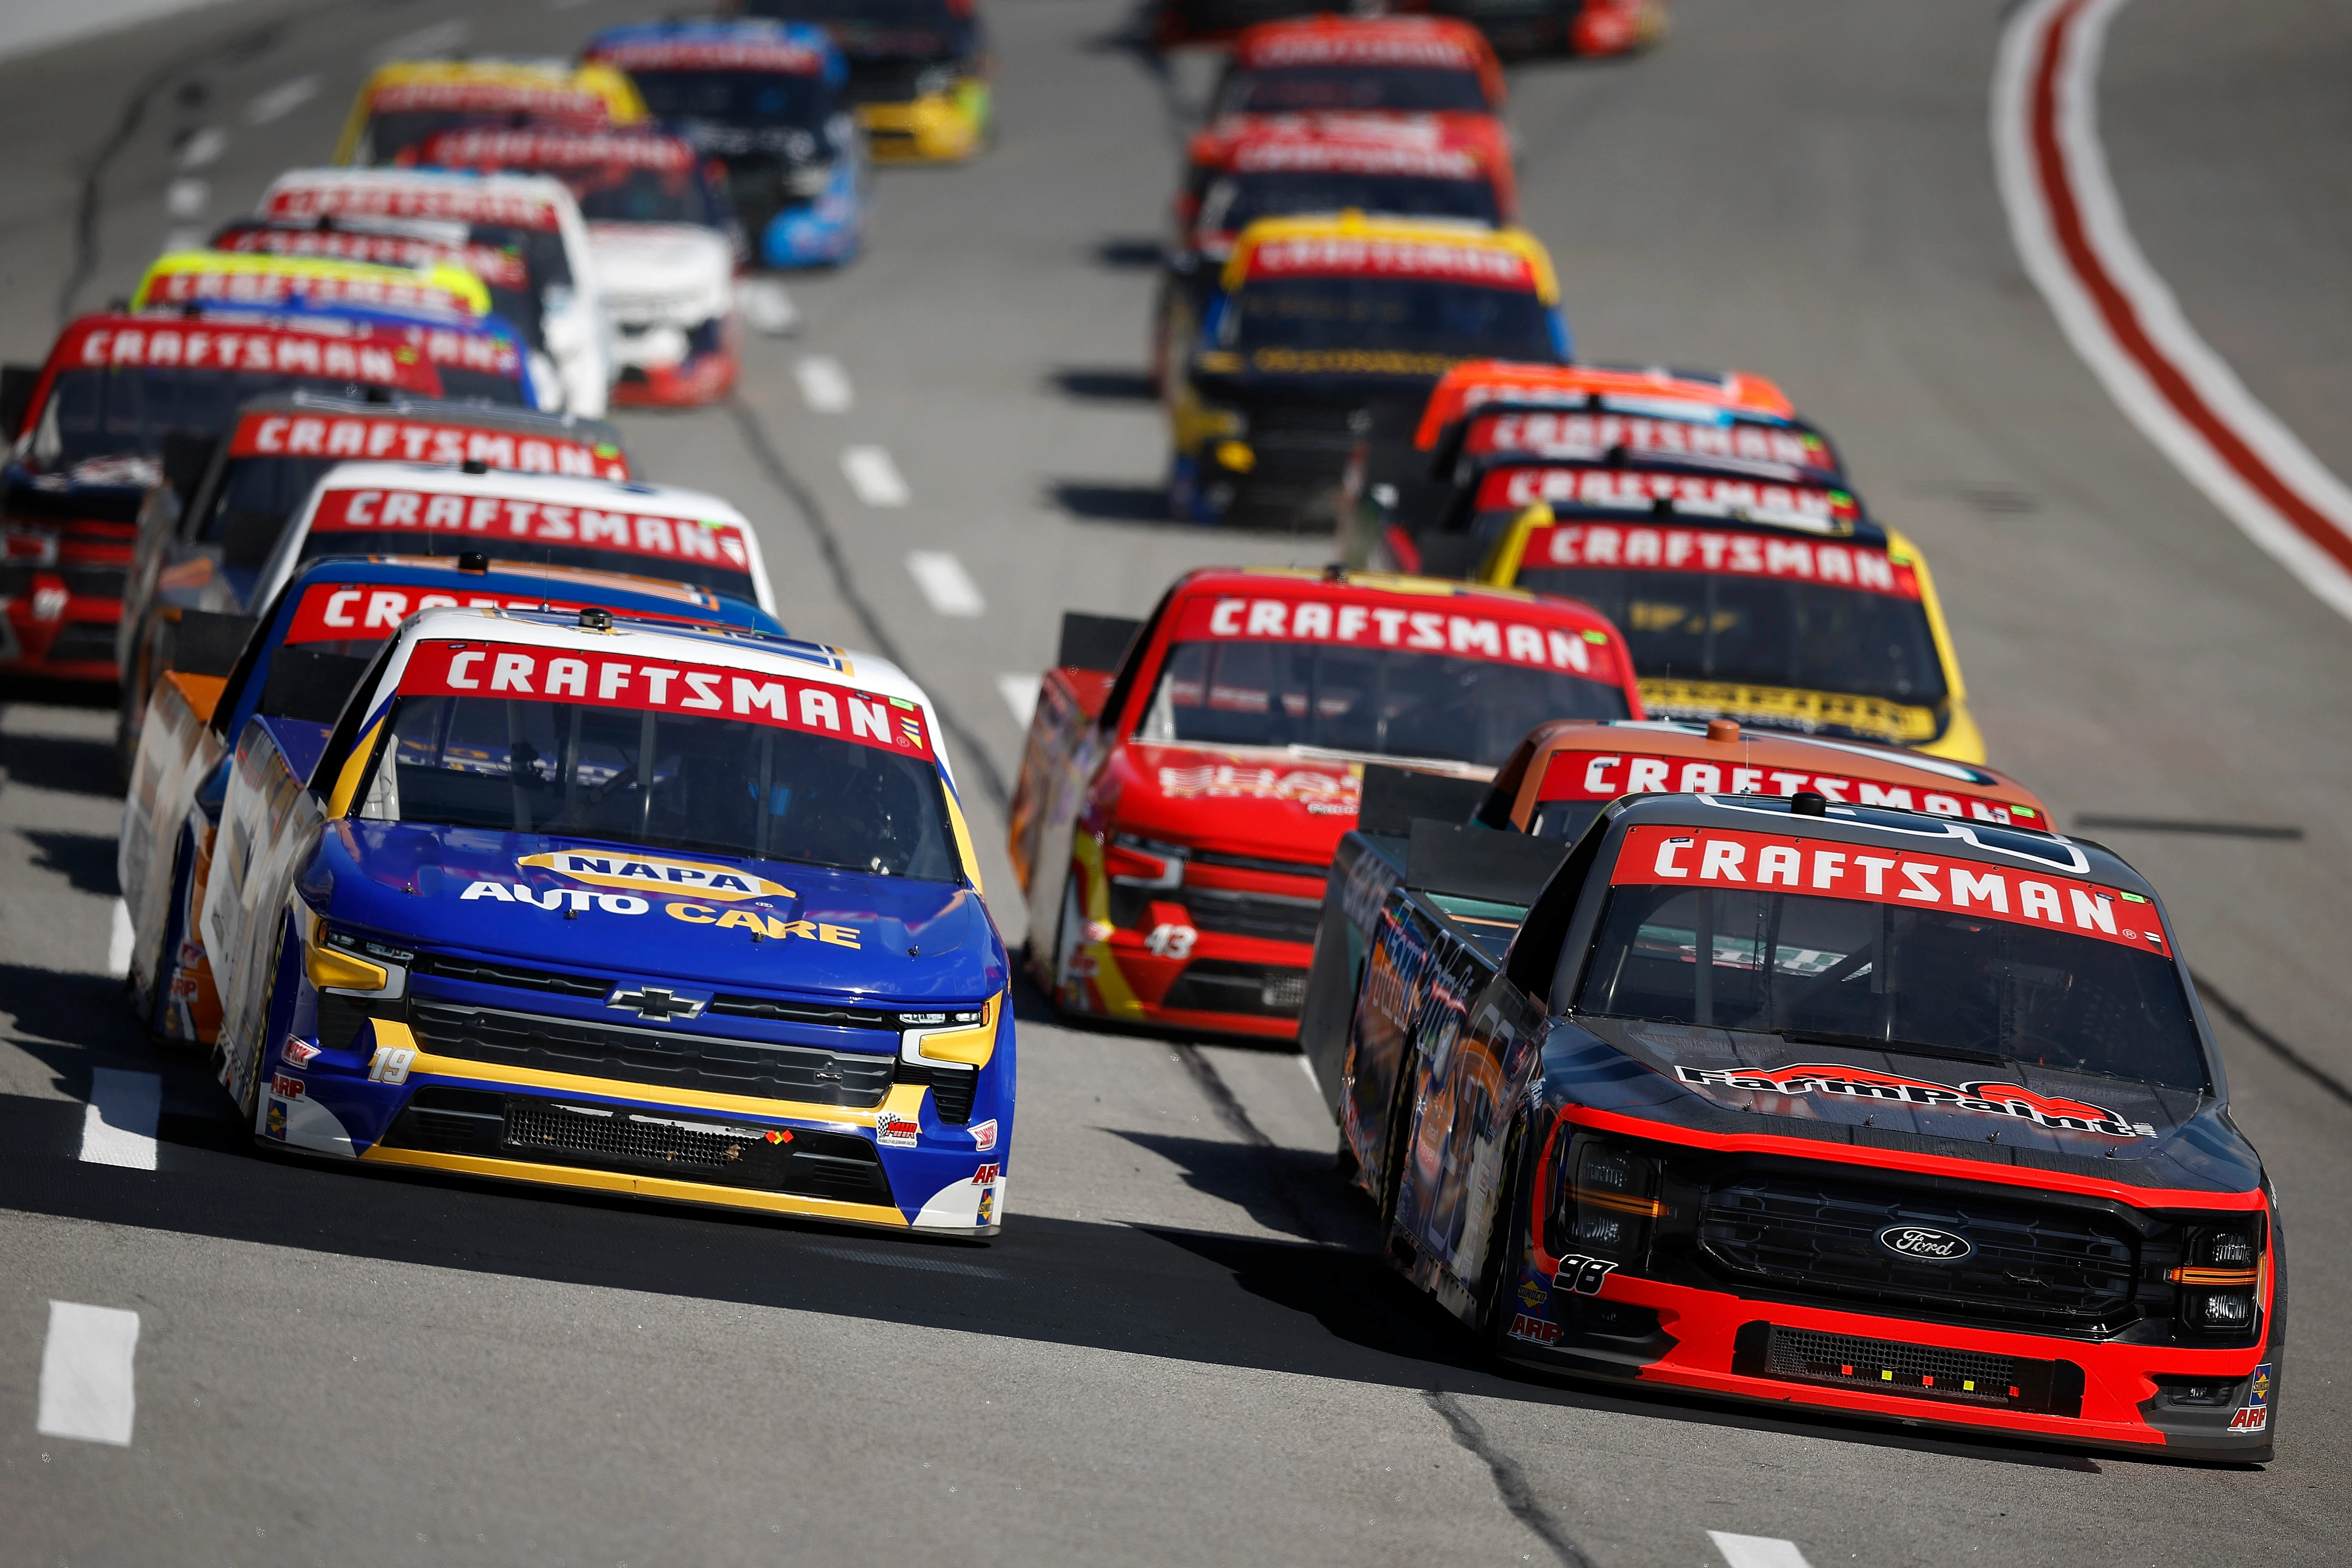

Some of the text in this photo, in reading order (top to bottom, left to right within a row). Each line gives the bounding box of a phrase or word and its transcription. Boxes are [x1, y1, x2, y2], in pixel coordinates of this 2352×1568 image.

[83, 329, 397, 382] CRAFTSMAN
[256, 418, 595, 478] CRAFTSMAN
[345, 490, 720, 559] CRAFTSMAN
[1549, 526, 1894, 589] CRAFTSMAN
[1210, 600, 1589, 673] CRAFTSMAN
[447, 652, 892, 744] CRAFTSMAN
[1583, 757, 2012, 824] CRAFTSMAN
[569, 856, 753, 892] NAPA
[1654, 838, 2119, 935] CRAFTSMAN
[460, 881, 861, 950] AUTO CARE
[1145, 923, 1198, 959] 43
[270, 1075, 305, 1098] ARP
[369, 1046, 417, 1086] 19
[1675, 1064, 2136, 1137] FarmPaint
[1896, 1230, 1955, 1256] Ford
[1518, 1286, 1547, 1303] SUNOCO
[1552, 1254, 1619, 1296] 98
[1511, 1314, 1563, 1341] ARP
[2230, 1407, 2266, 1428] ARP
